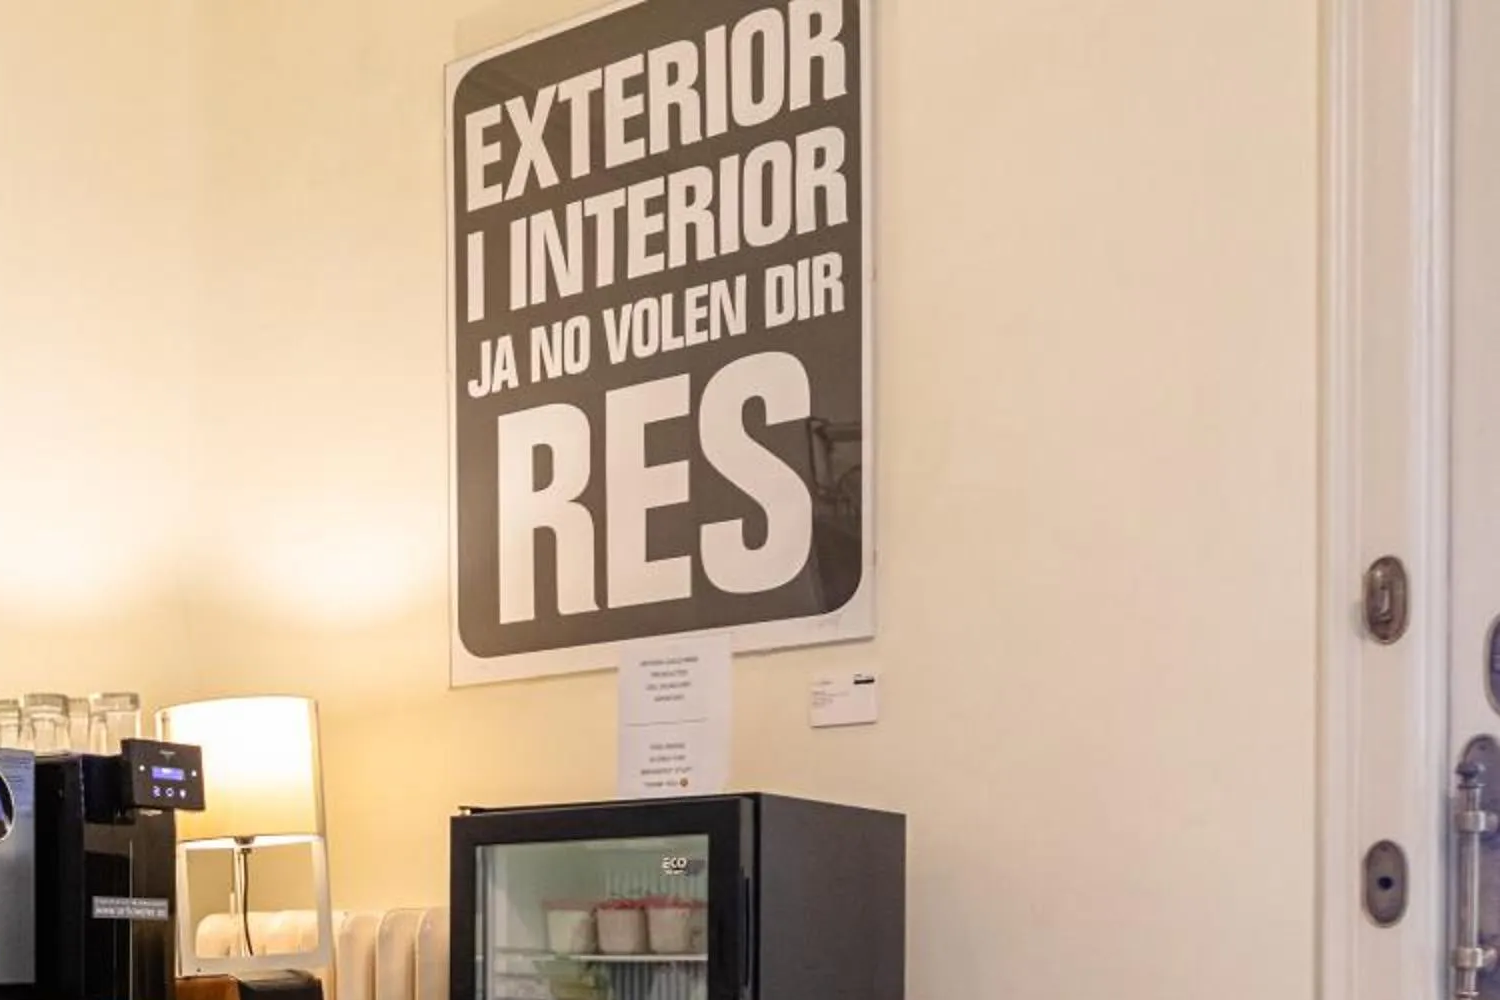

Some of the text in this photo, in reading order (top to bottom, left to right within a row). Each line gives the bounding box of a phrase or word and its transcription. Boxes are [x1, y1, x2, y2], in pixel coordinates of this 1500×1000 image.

[465, 0, 848, 213] EXTERIOR
[467, 126, 849, 323] I INTERIOR
[467, 251, 845, 399] JA NO VOLEN DIR
[497, 351, 813, 625] RES
[663, 857, 687, 868] ECO
